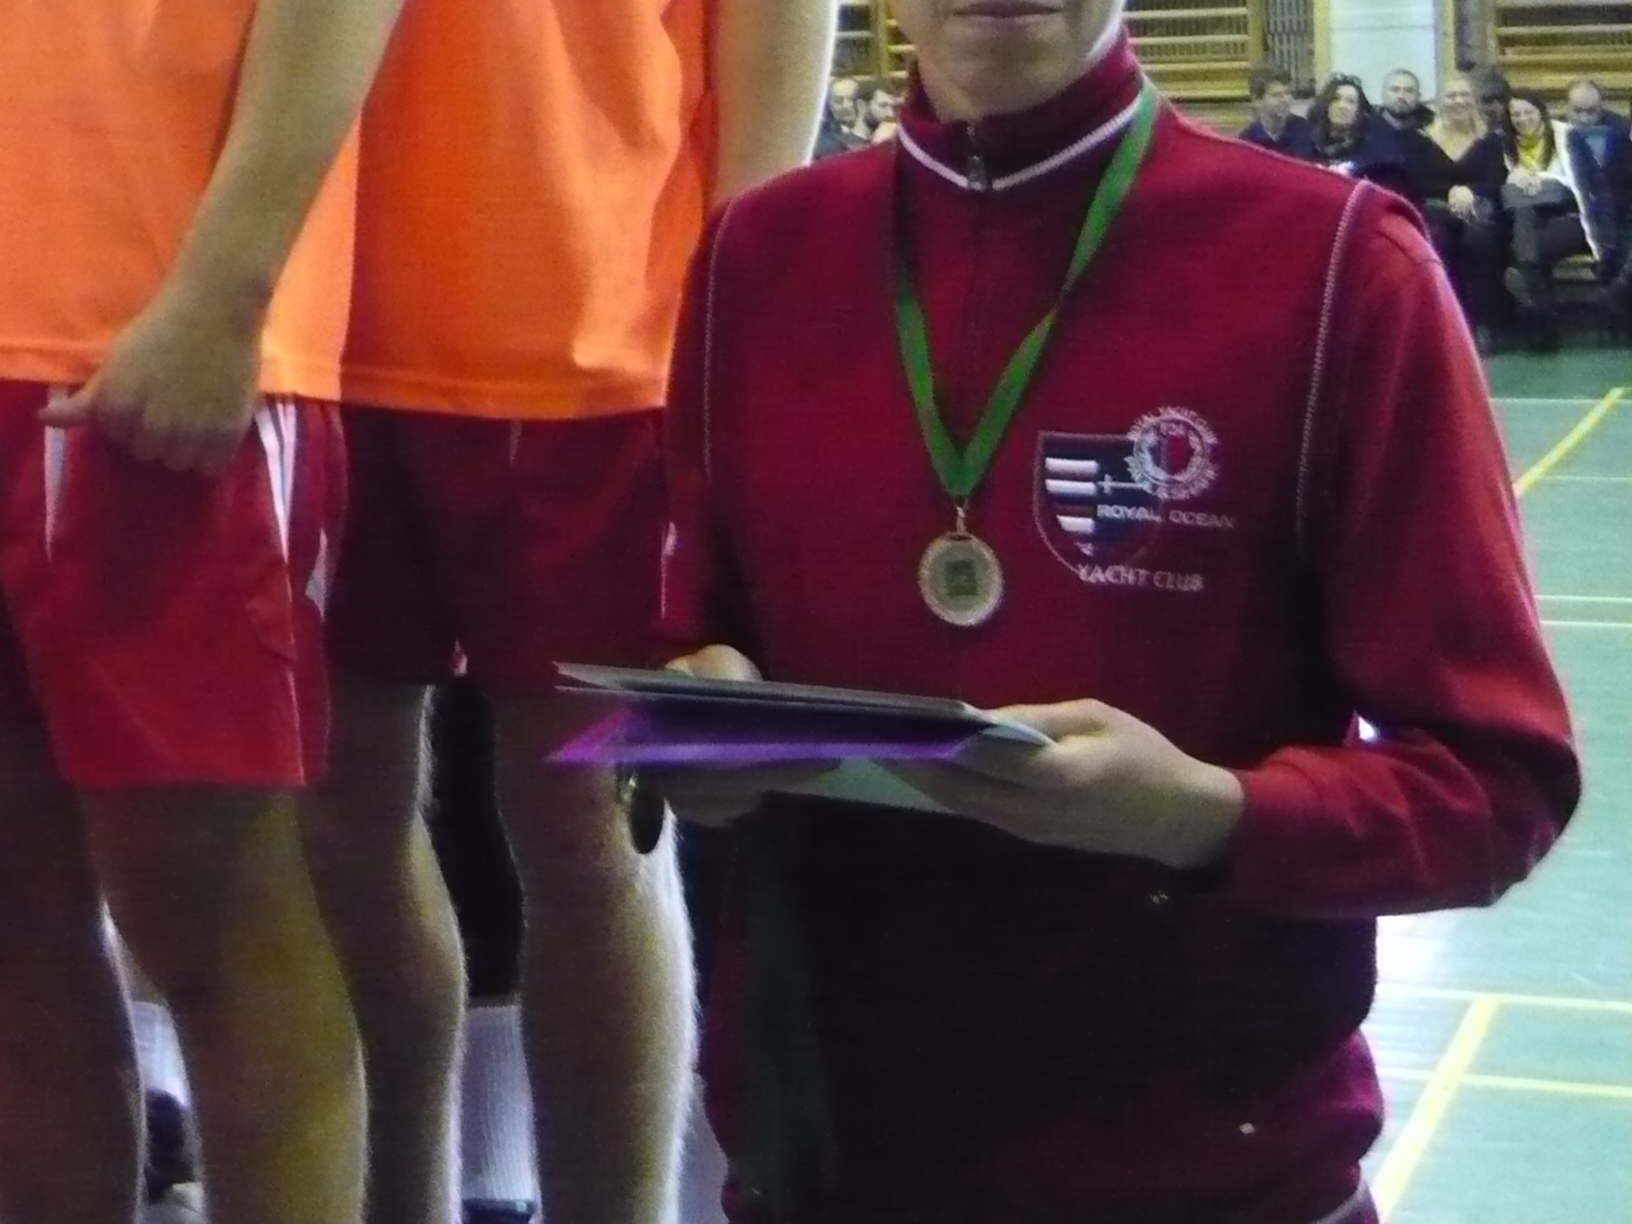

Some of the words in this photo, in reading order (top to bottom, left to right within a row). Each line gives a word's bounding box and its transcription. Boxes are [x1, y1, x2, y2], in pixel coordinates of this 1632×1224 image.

[1097, 504, 1164, 524] ROYAL
[1168, 509, 1235, 529] OCEAN
[1077, 563, 1150, 586] YACHT
[1152, 570, 1205, 592] CLUB
